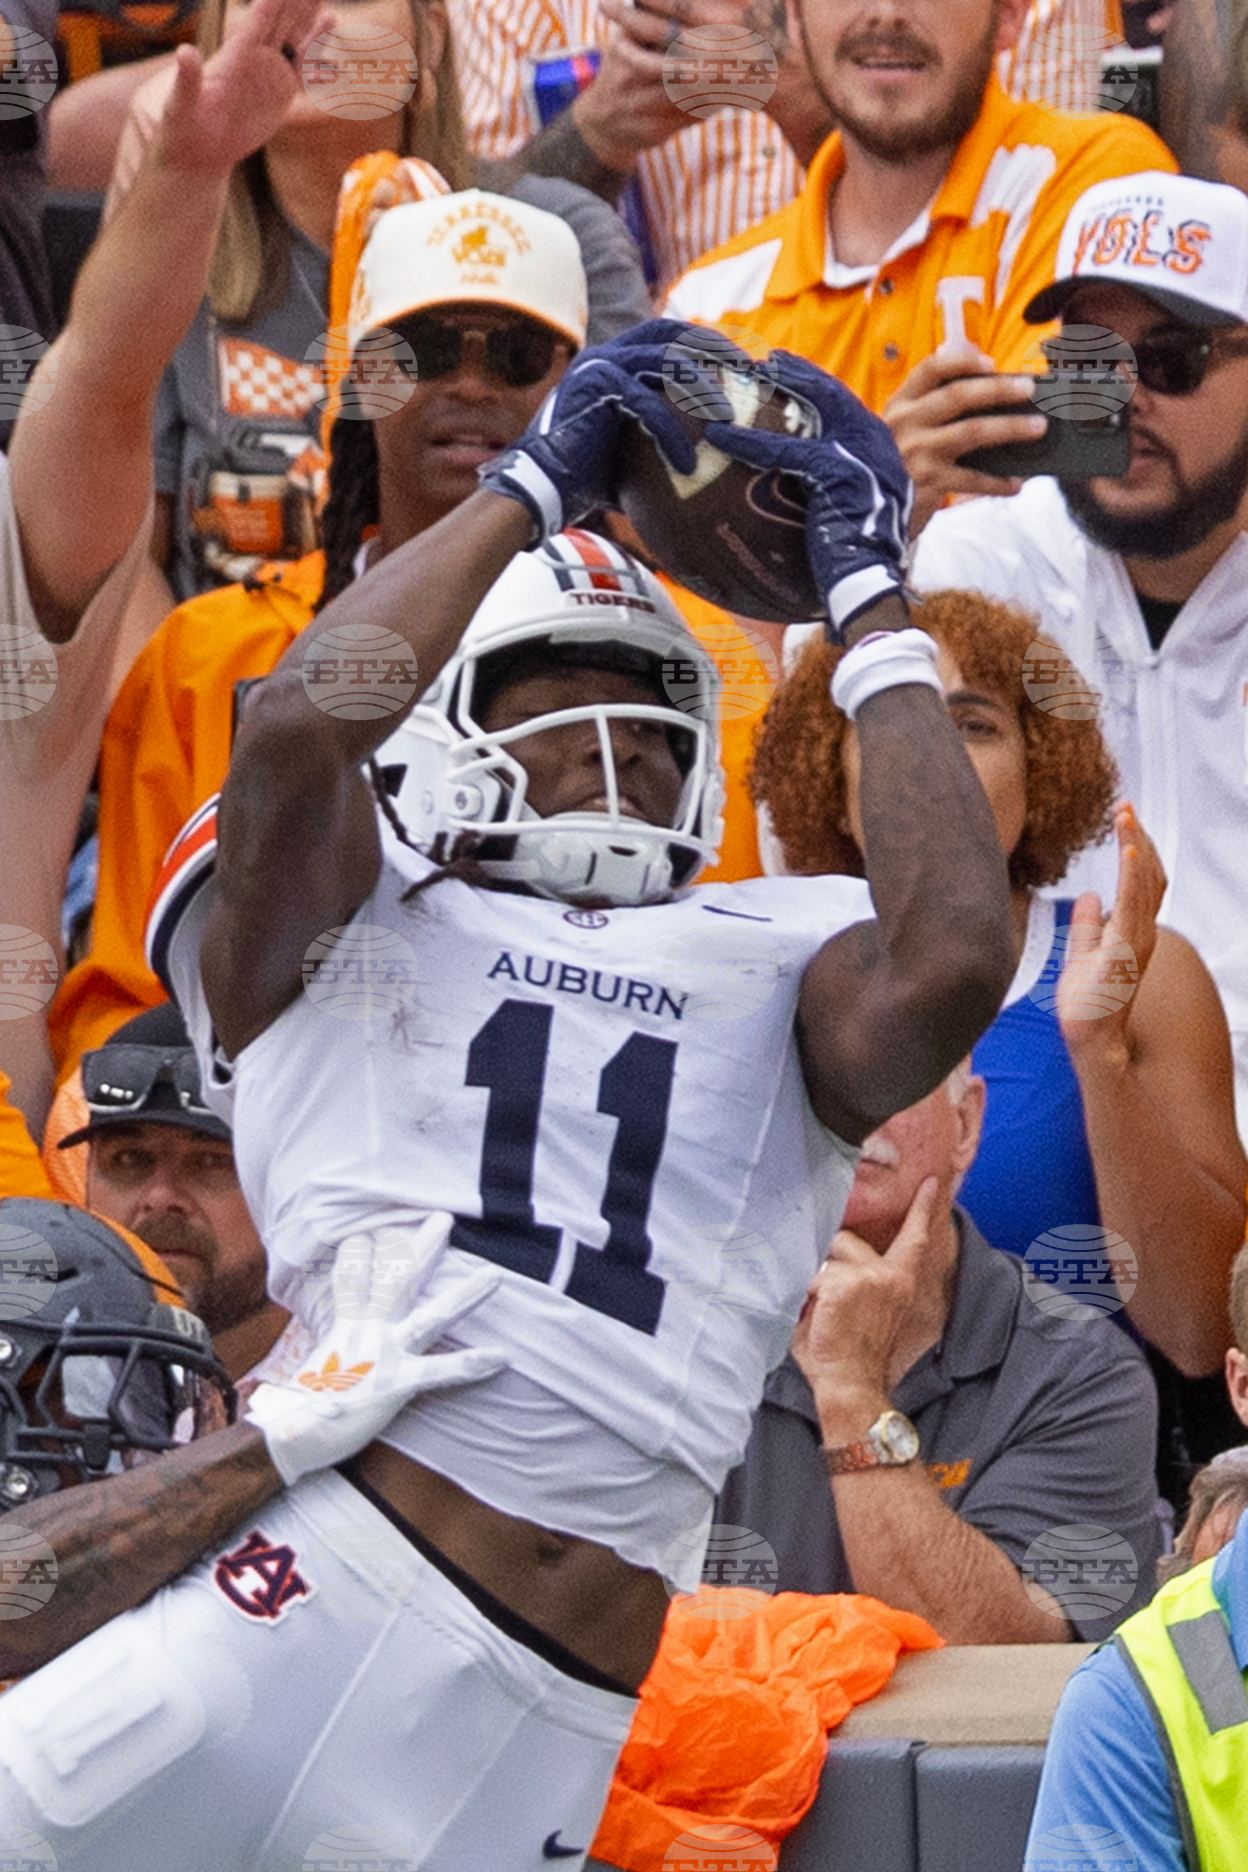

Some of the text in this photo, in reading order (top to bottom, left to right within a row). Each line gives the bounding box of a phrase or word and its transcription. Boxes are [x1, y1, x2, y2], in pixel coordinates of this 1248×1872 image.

[1072, 187, 1211, 277] VOLS
[487, 951, 689, 1020] AUBURN
[449, 997, 680, 1338] 11
